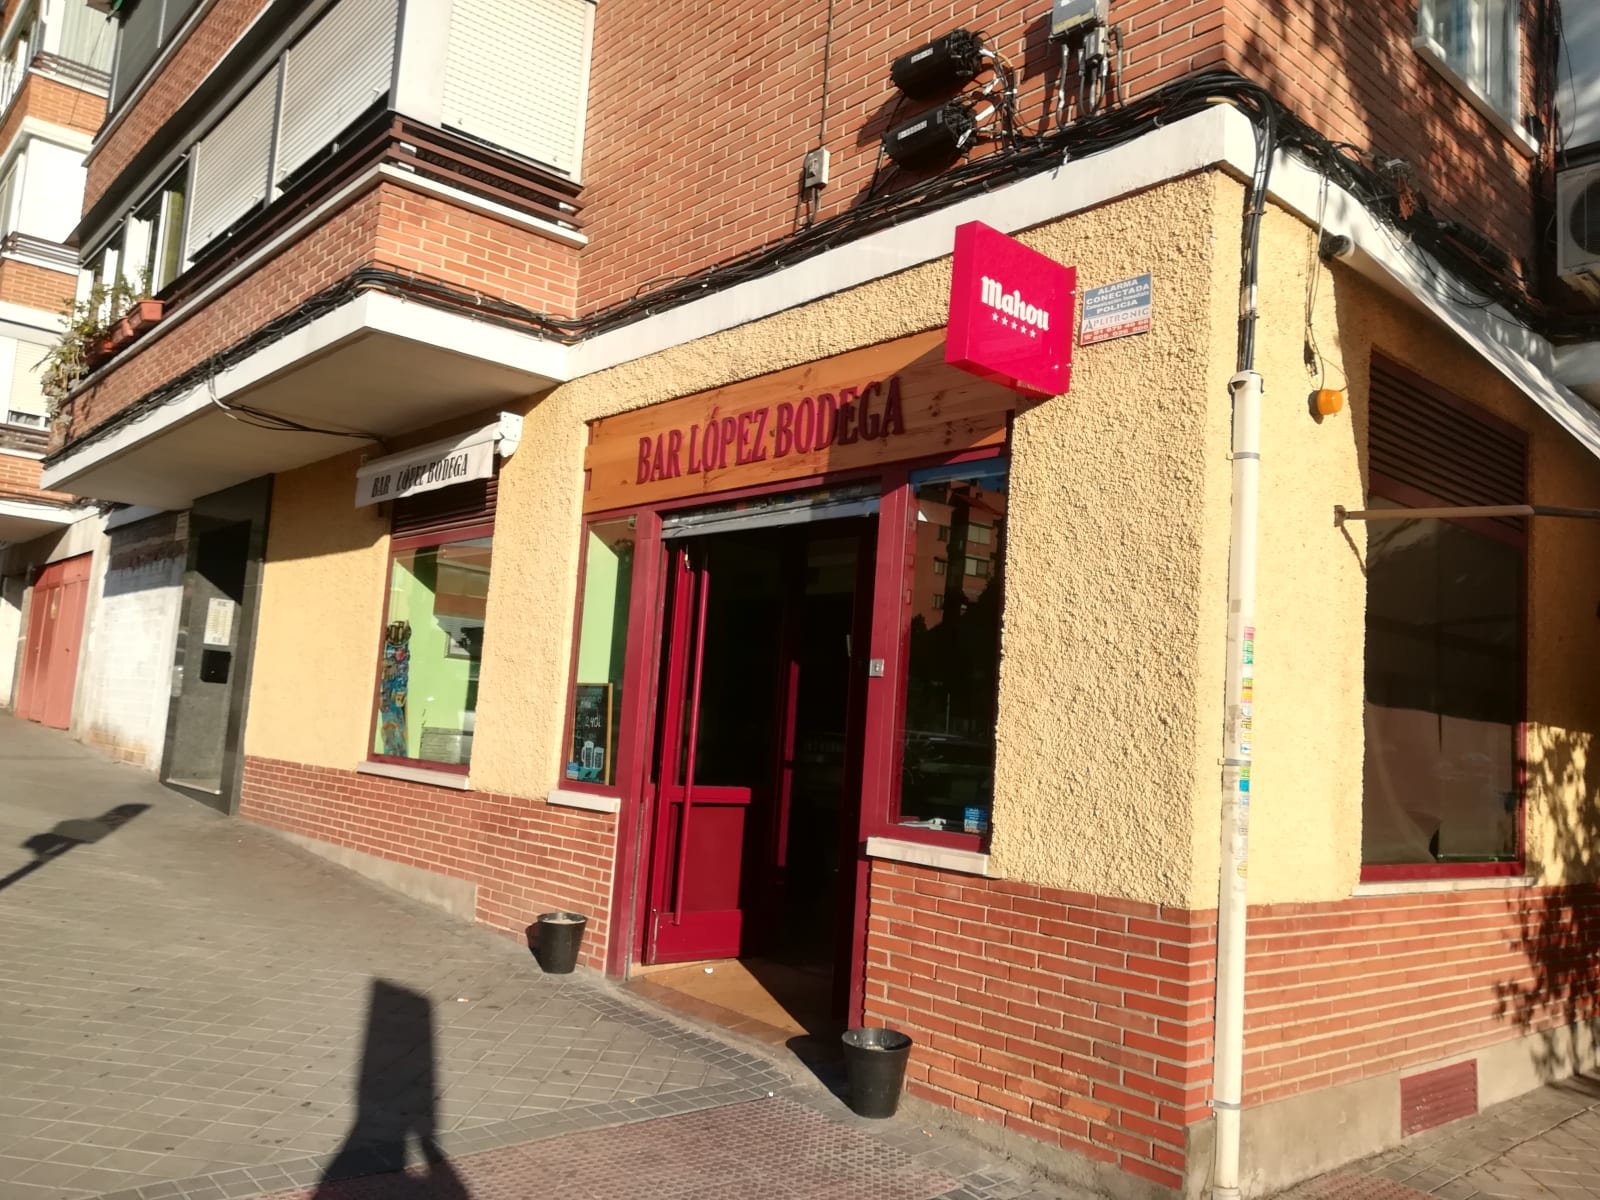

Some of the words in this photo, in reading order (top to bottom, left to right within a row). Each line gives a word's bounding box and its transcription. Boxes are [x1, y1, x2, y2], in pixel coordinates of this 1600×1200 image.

[1086, 283, 1150, 305] CONECTADA
[1097, 279, 1138, 295] ALARMA
[980, 275, 1049, 331] Mahou
[1096, 299, 1138, 315] POLICIA
[1085, 307, 1150, 331] APLITRONIC
[635, 429, 682, 485] BAR
[687, 406, 769, 476] LÓPEZ
[773, 375, 905, 458] BODEGA
[371, 474, 391, 498] BAR
[396, 463, 427, 492] LÓPEZ
[427, 453, 468, 484] BODEGA
